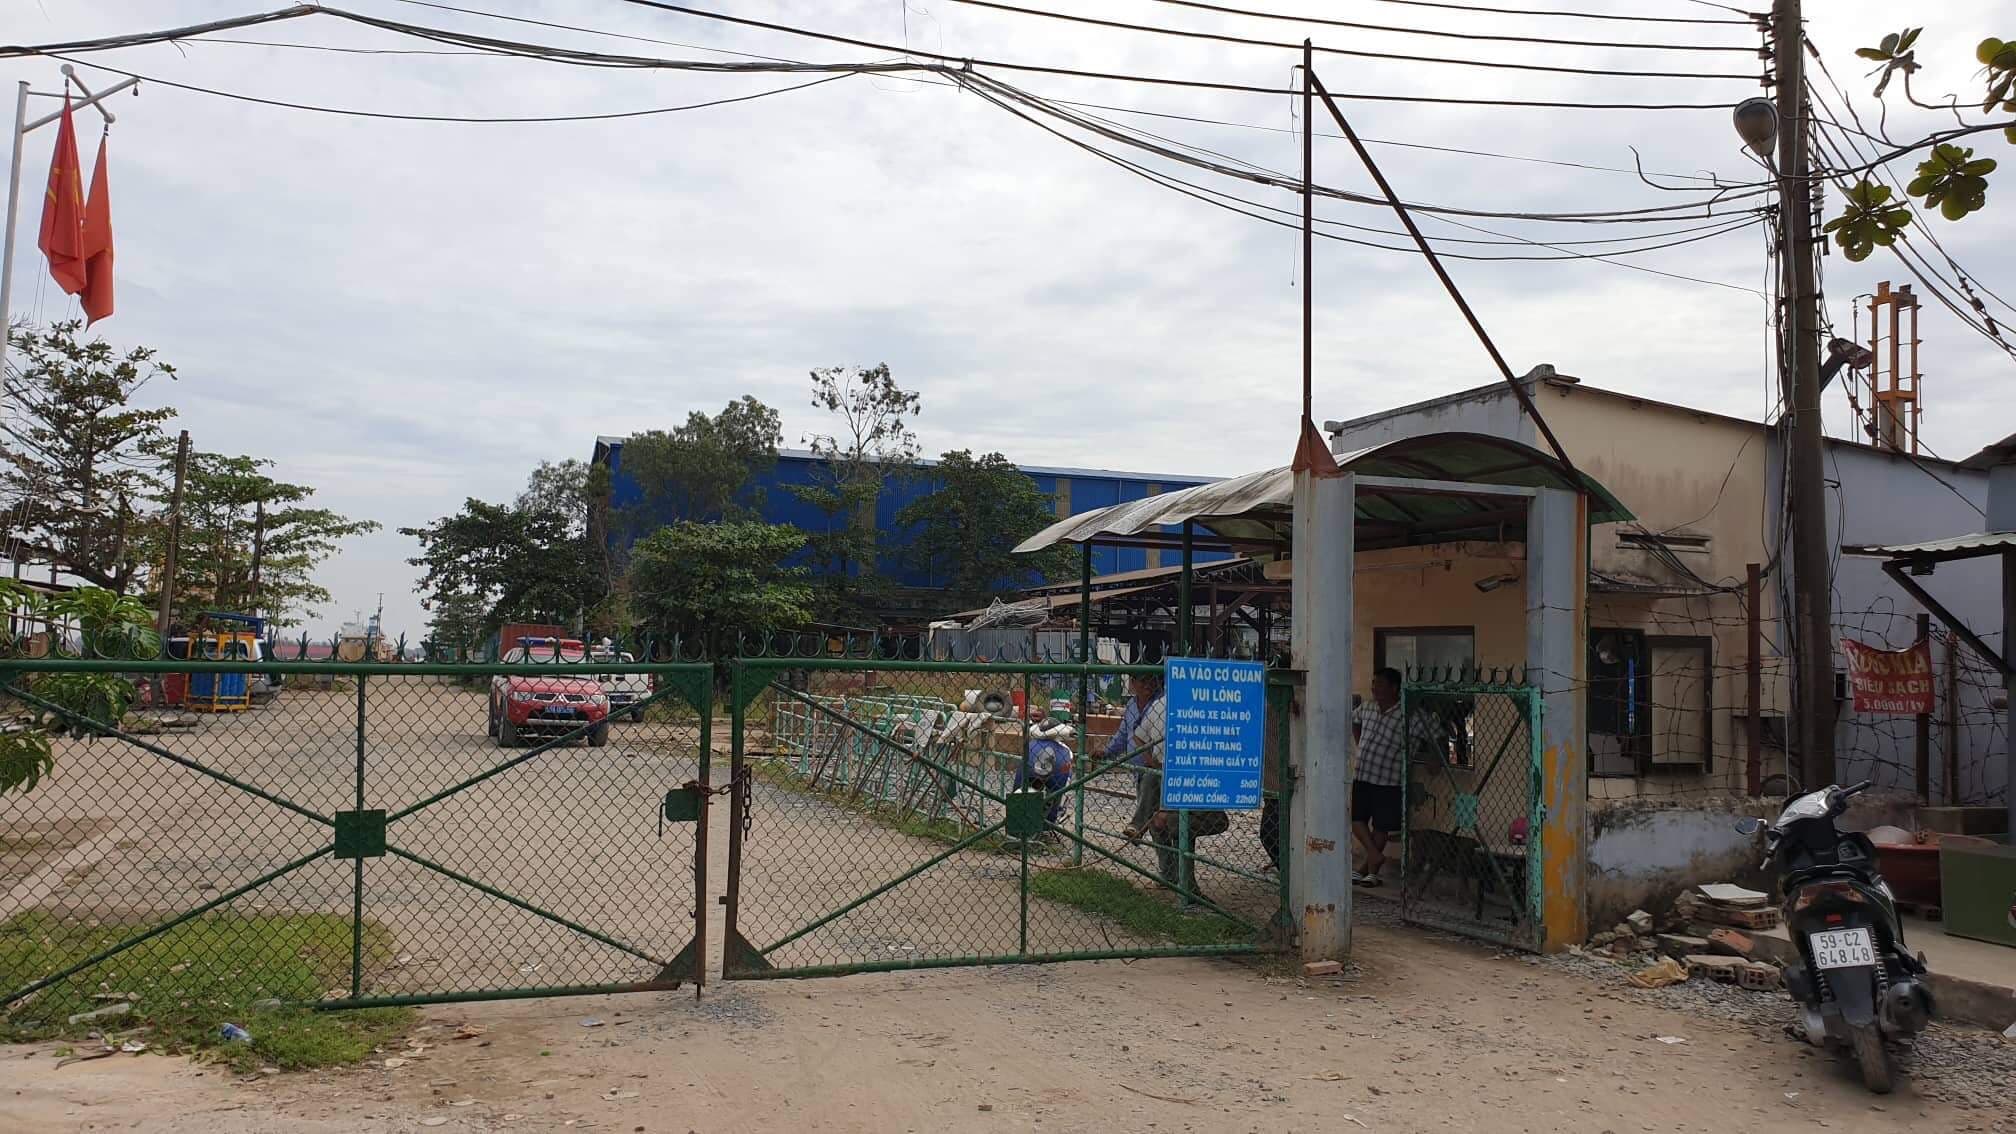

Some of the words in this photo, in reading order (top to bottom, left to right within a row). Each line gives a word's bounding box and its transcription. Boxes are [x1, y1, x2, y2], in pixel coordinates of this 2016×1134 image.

[1172, 666, 1186, 680] RA
[1189, 664, 1211, 680] VÀO
[1214, 666, 1229, 682] CƠ
[1232, 668, 1262, 682] QUAN
[1192, 688, 1210, 701] VUI
[1212, 686, 1242, 703] LÒNG
[1208, 710, 1220, 720] XE
[1215, 742, 1242, 752] TRANG
[1240, 780, 1258, 788] 5h00
[1236, 794, 1256, 804] 22h00
[1820, 932, 1861, 949] 59-C2
